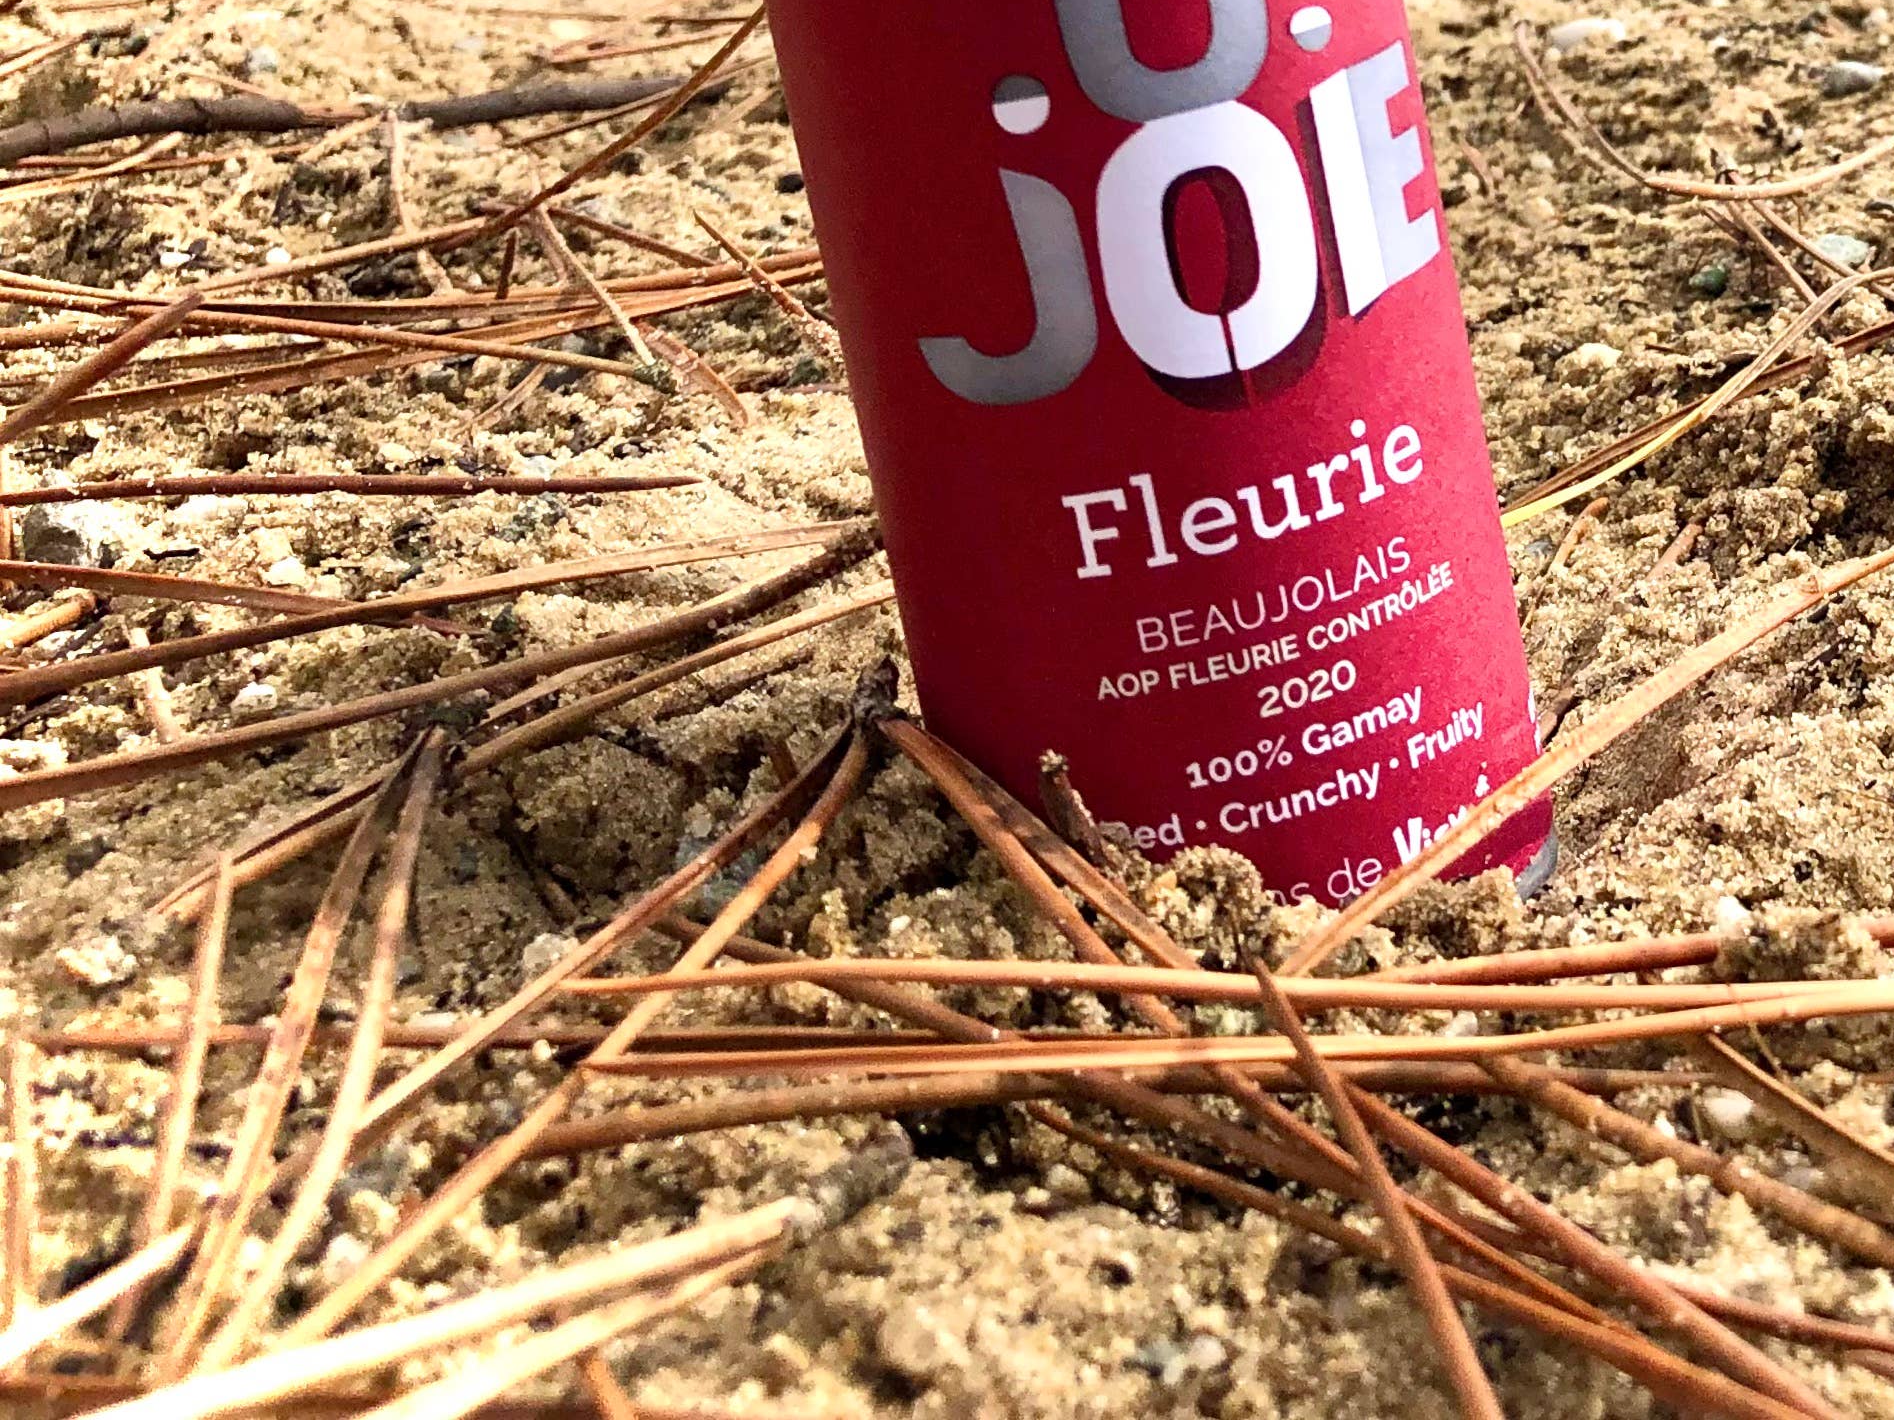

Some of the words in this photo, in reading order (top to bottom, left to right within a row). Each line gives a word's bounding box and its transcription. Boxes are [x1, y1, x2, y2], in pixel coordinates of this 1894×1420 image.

[1062, 419, 1423, 579] Fleurie
[1098, 669, 1160, 701] AOP
[1169, 635, 1300, 690] FLEURIE
[1307, 561, 1454, 651] CONTRÔLÉE
[1136, 537, 1411, 653] BEAUJOLAIS
[1185, 735, 1293, 789] 100%
[1301, 685, 1422, 755] Gamay
[1257, 660, 1357, 718] 2020
[1100, 812, 1185, 850] ed
[1219, 762, 1380, 833] Crunchy
[1406, 702, 1483, 769] Fruity
[1327, 857, 1383, 901] de
